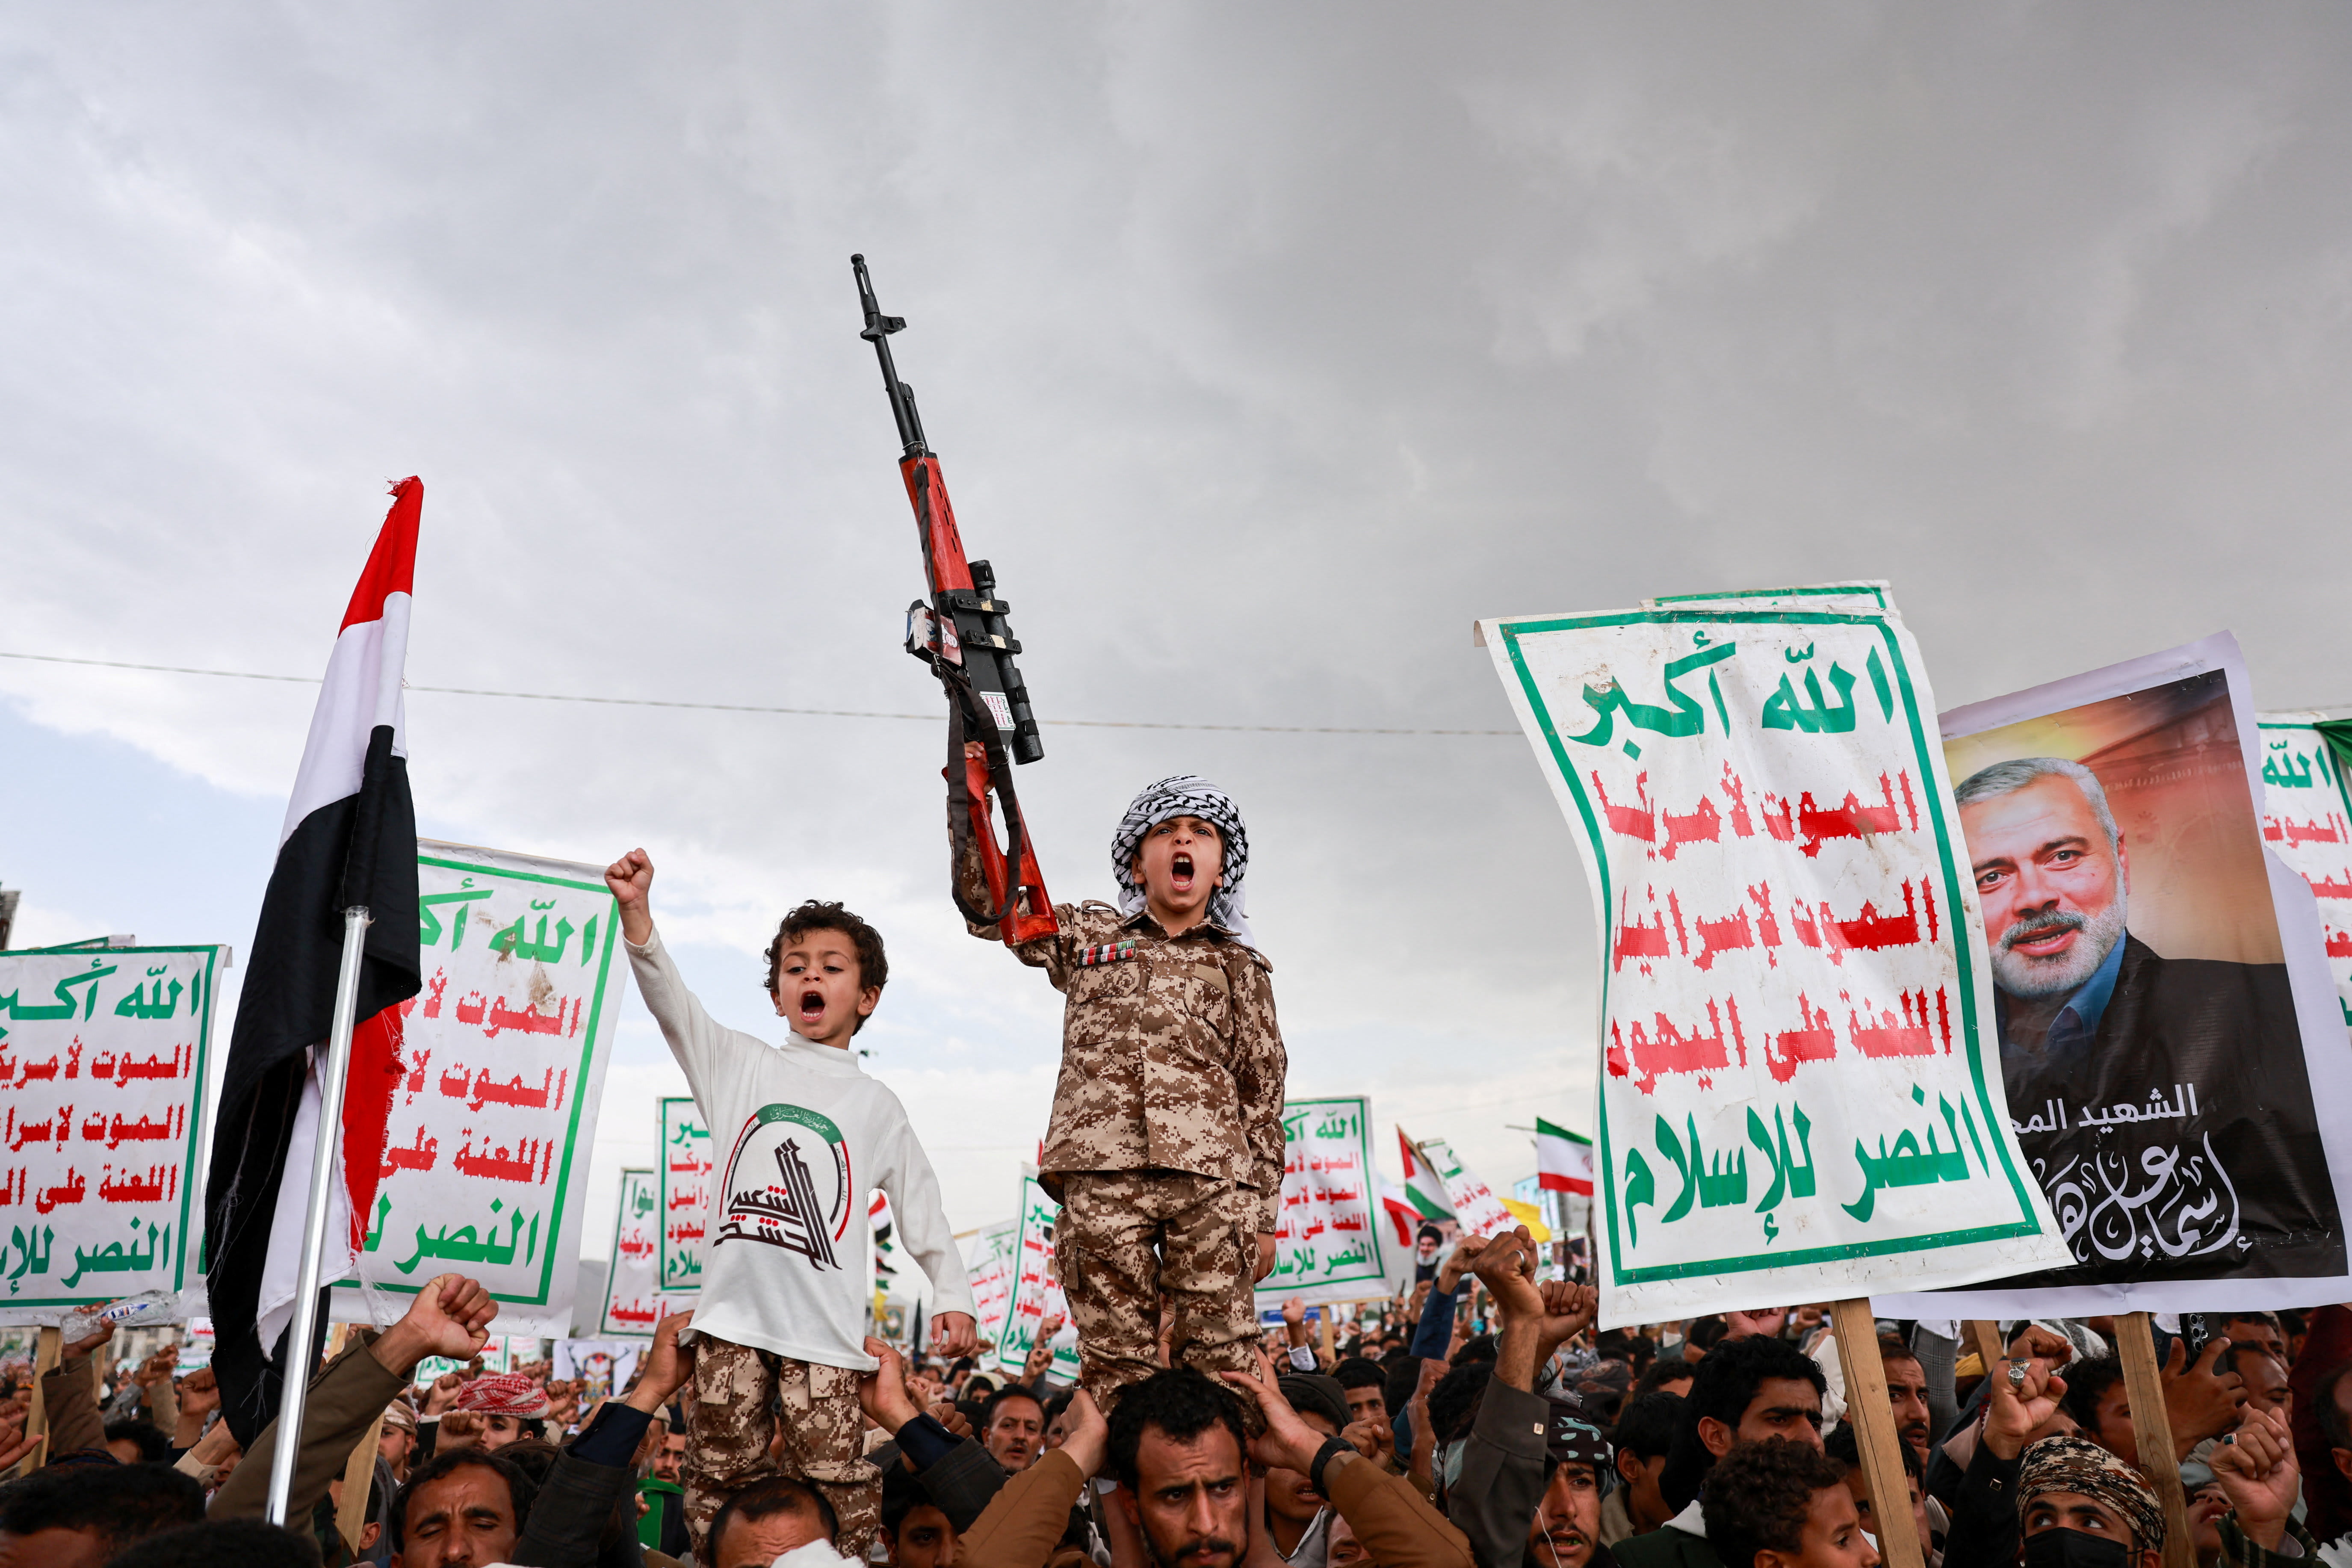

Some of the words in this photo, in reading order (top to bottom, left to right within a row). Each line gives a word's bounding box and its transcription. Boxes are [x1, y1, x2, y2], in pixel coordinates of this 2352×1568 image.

[1567, 629, 1736, 761] أكبر
[1762, 641, 1894, 734] الله
[1760, 767, 1919, 859] الموت
[488, 899, 598, 968] الله
[1792, 873, 1938, 968] الموت
[114, 964, 200, 1019] الله
[456, 993, 582, 1039] الموت
[1606, 992, 1749, 1096] اليهود
[1764, 989, 1837, 1085] على
[91, 1042, 192, 1089] الموت
[439, 1061, 568, 1113] الموت
[3, 1104, 74, 1154] لإسرا
[81, 1102, 184, 1151] الموت
[1315, 1110, 1358, 1140] الله
[2011, 1098, 2067, 1139] المج
[2078, 1083, 2198, 1134] الشهيد
[452, 1126, 554, 1187] اللعنة
[1311, 1152, 1359, 1175] الموت
[1625, 1100, 1816, 1249] للإسلام
[1841, 1082, 1990, 1223] النصر
[35, 1164, 86, 1215] على
[98, 1162, 177, 1203] اللعنة
[1315, 1182, 1364, 1205] الموت
[393, 1197, 540, 1275] النصر
[668, 1219, 705, 1244] ليهود
[1301, 1216, 1324, 1241] على
[1332, 1212, 1368, 1231] اللعنة
[60, 1216, 170, 1289] النصر
[1268, 1246, 1315, 1282] للإسلا
[1323, 1237, 1374, 1276] النصر
